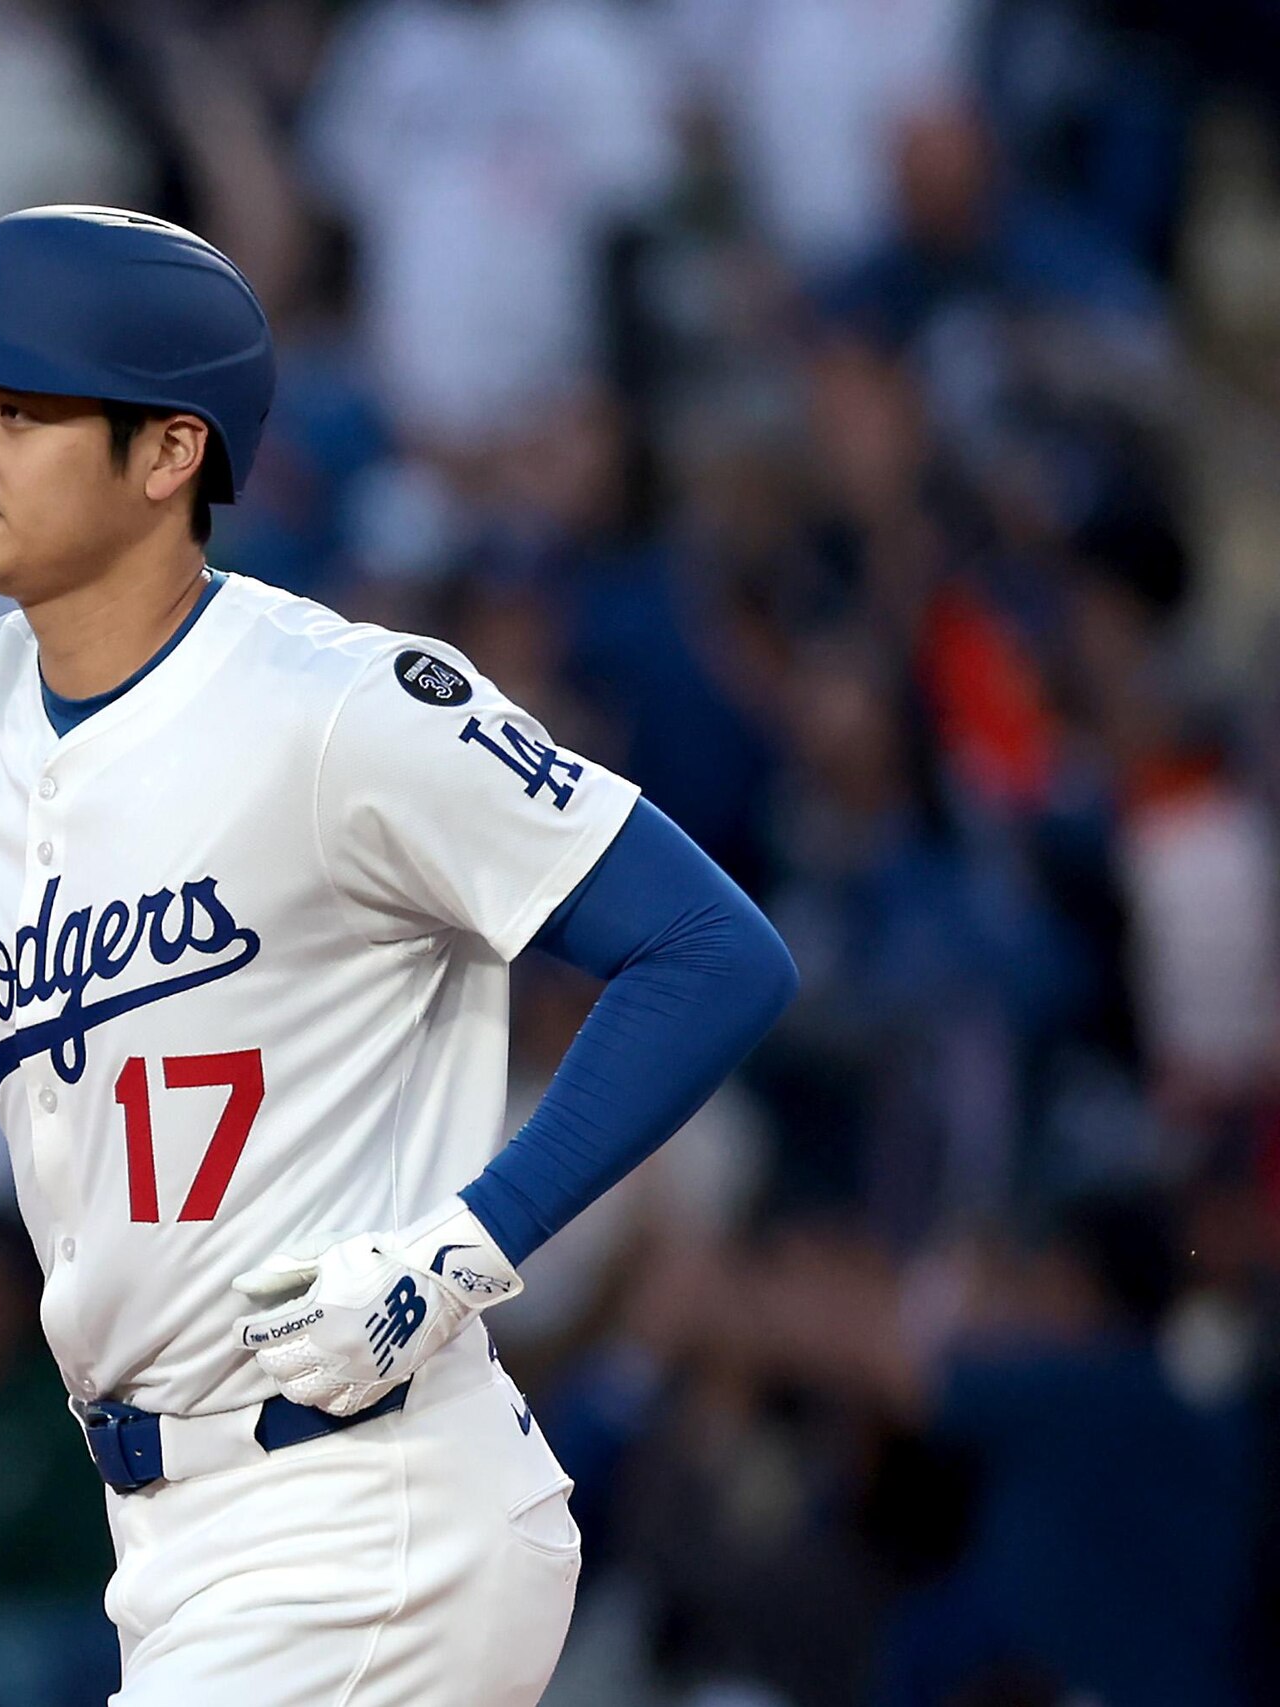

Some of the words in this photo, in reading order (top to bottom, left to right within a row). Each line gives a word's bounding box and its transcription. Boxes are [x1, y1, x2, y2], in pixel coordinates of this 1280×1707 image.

[418, 664, 464, 699] 34
[458, 715, 584, 812] LA
[114, 1048, 265, 1223] 17
[270, 1308, 325, 1339] balance
